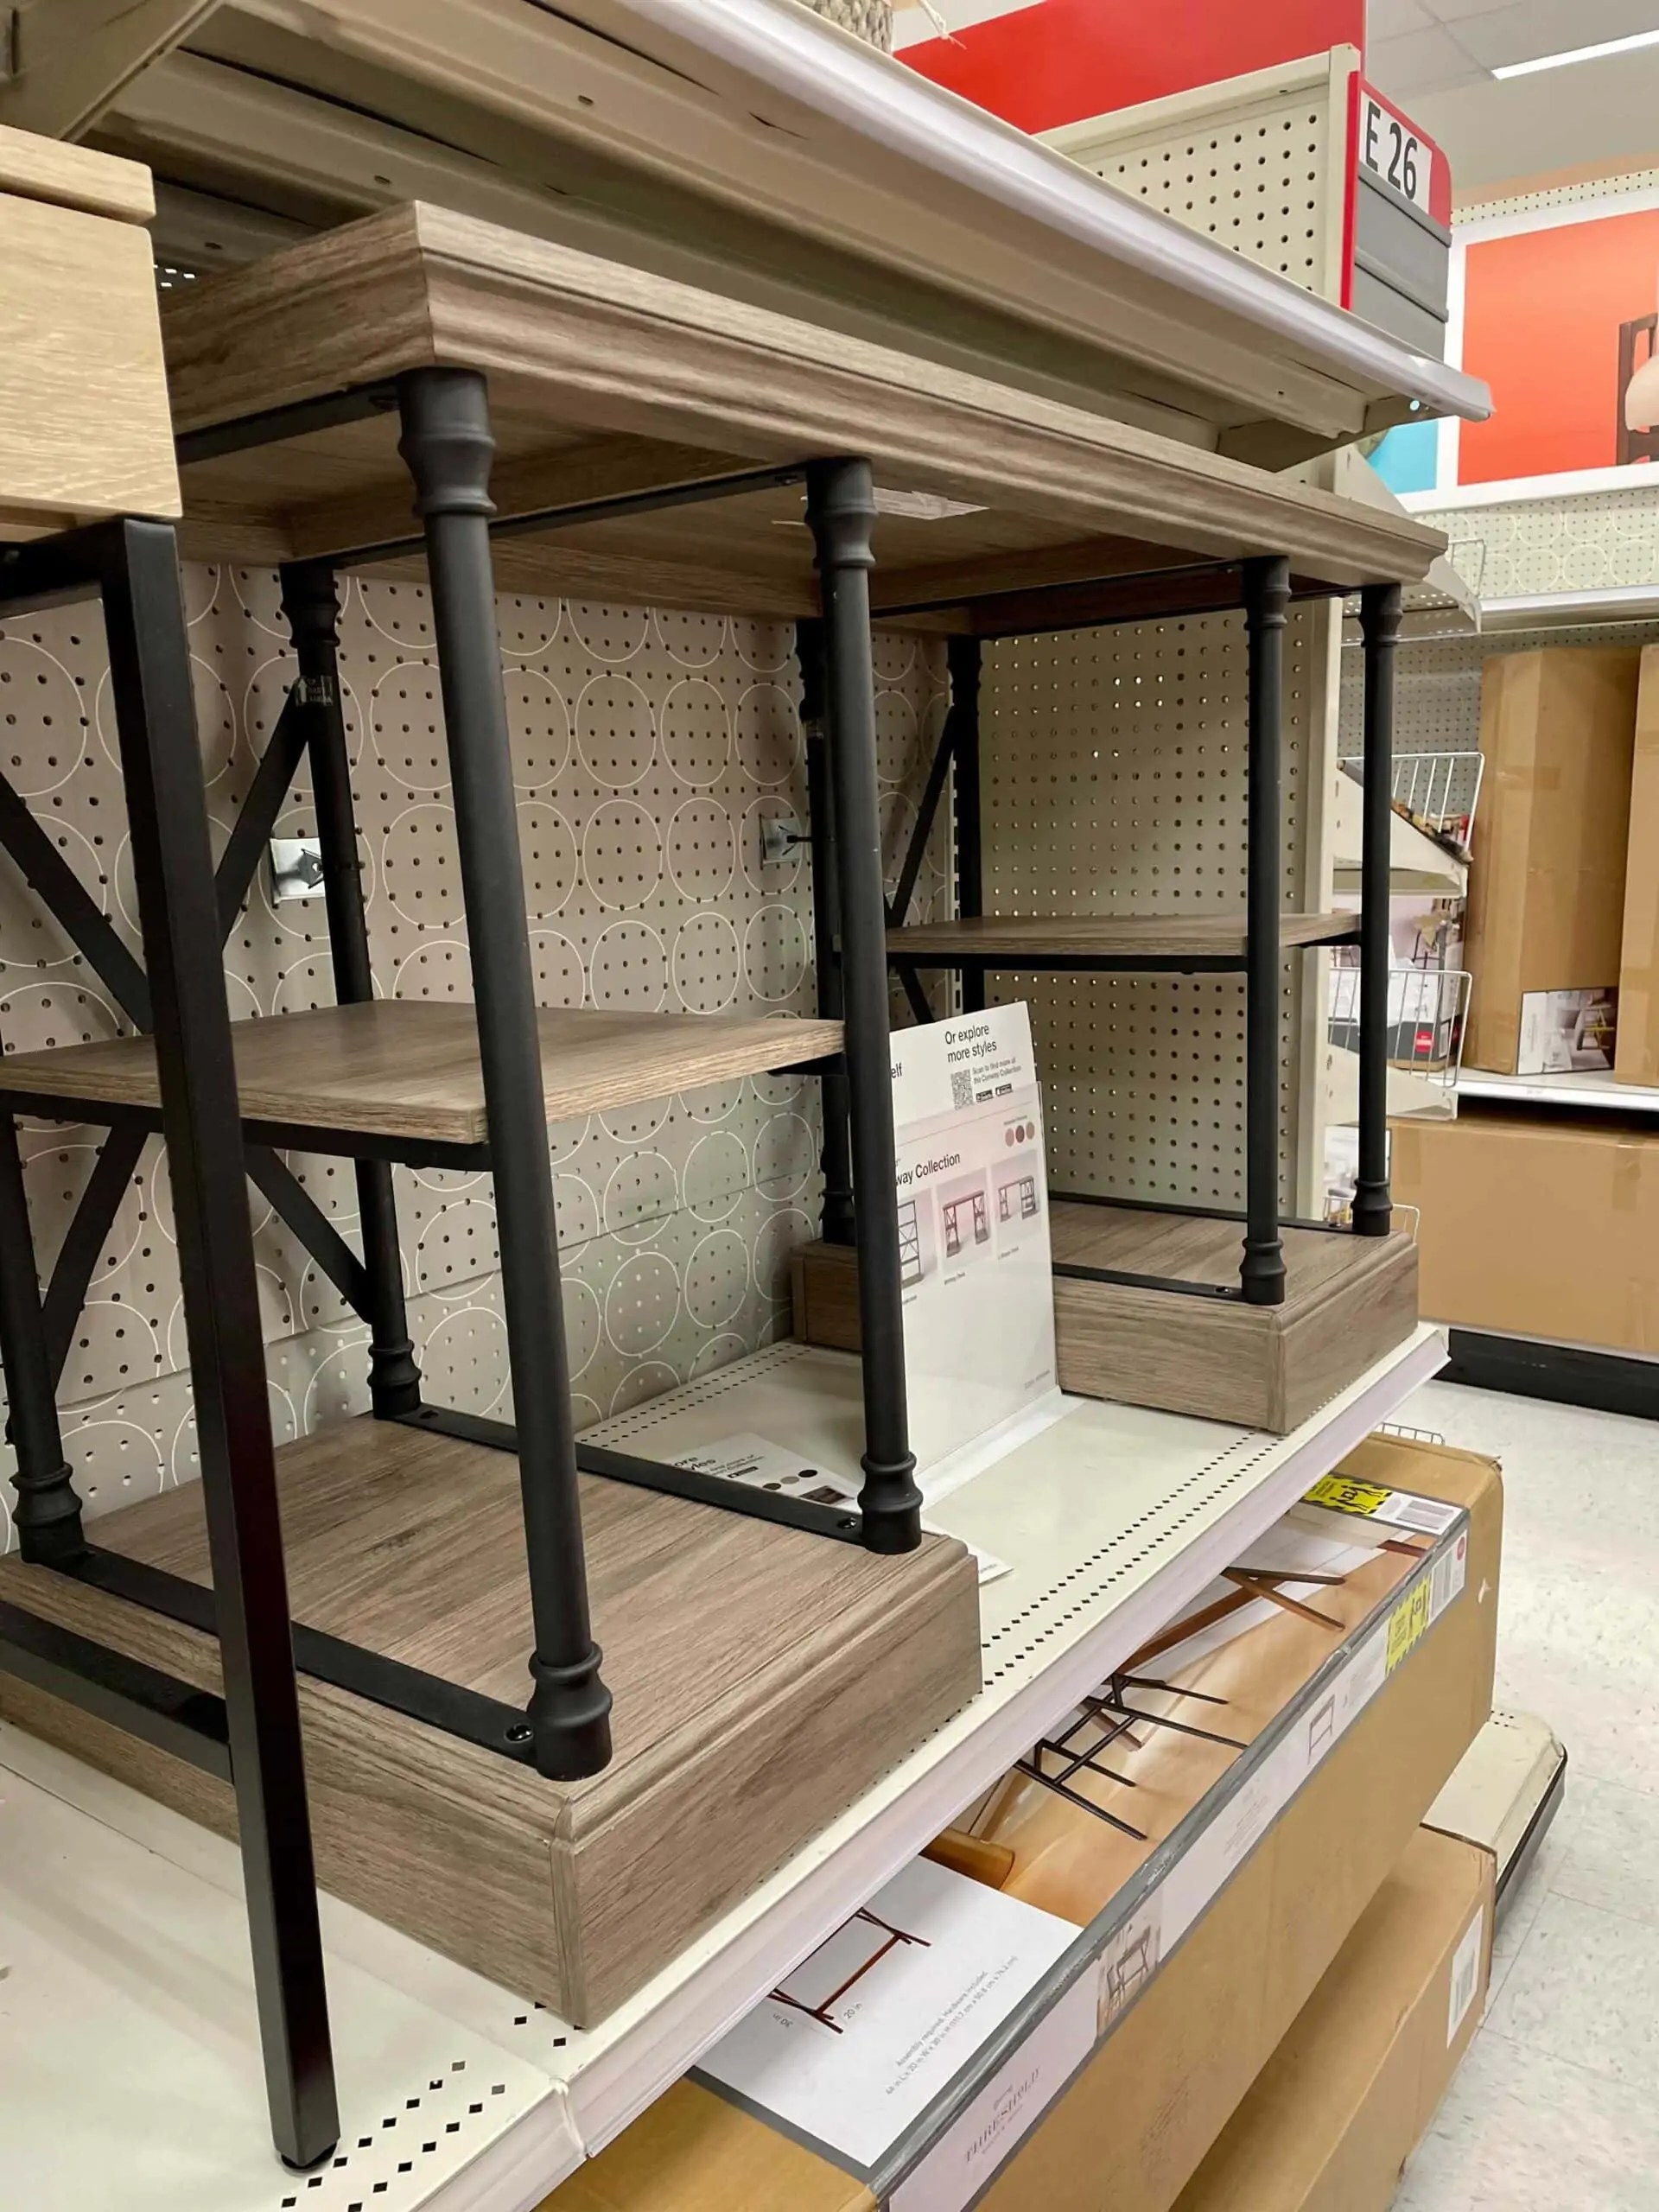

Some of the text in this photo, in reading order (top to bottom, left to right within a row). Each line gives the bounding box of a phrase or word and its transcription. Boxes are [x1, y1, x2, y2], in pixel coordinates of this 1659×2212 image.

[1366, 100, 1418, 200] E 26
[944, 1023, 989, 1045] Or explore
[947, 1039, 997, 1063] more styles
[891, 1062, 903, 1078] elf
[895, 1153, 961, 1186] way Collection
